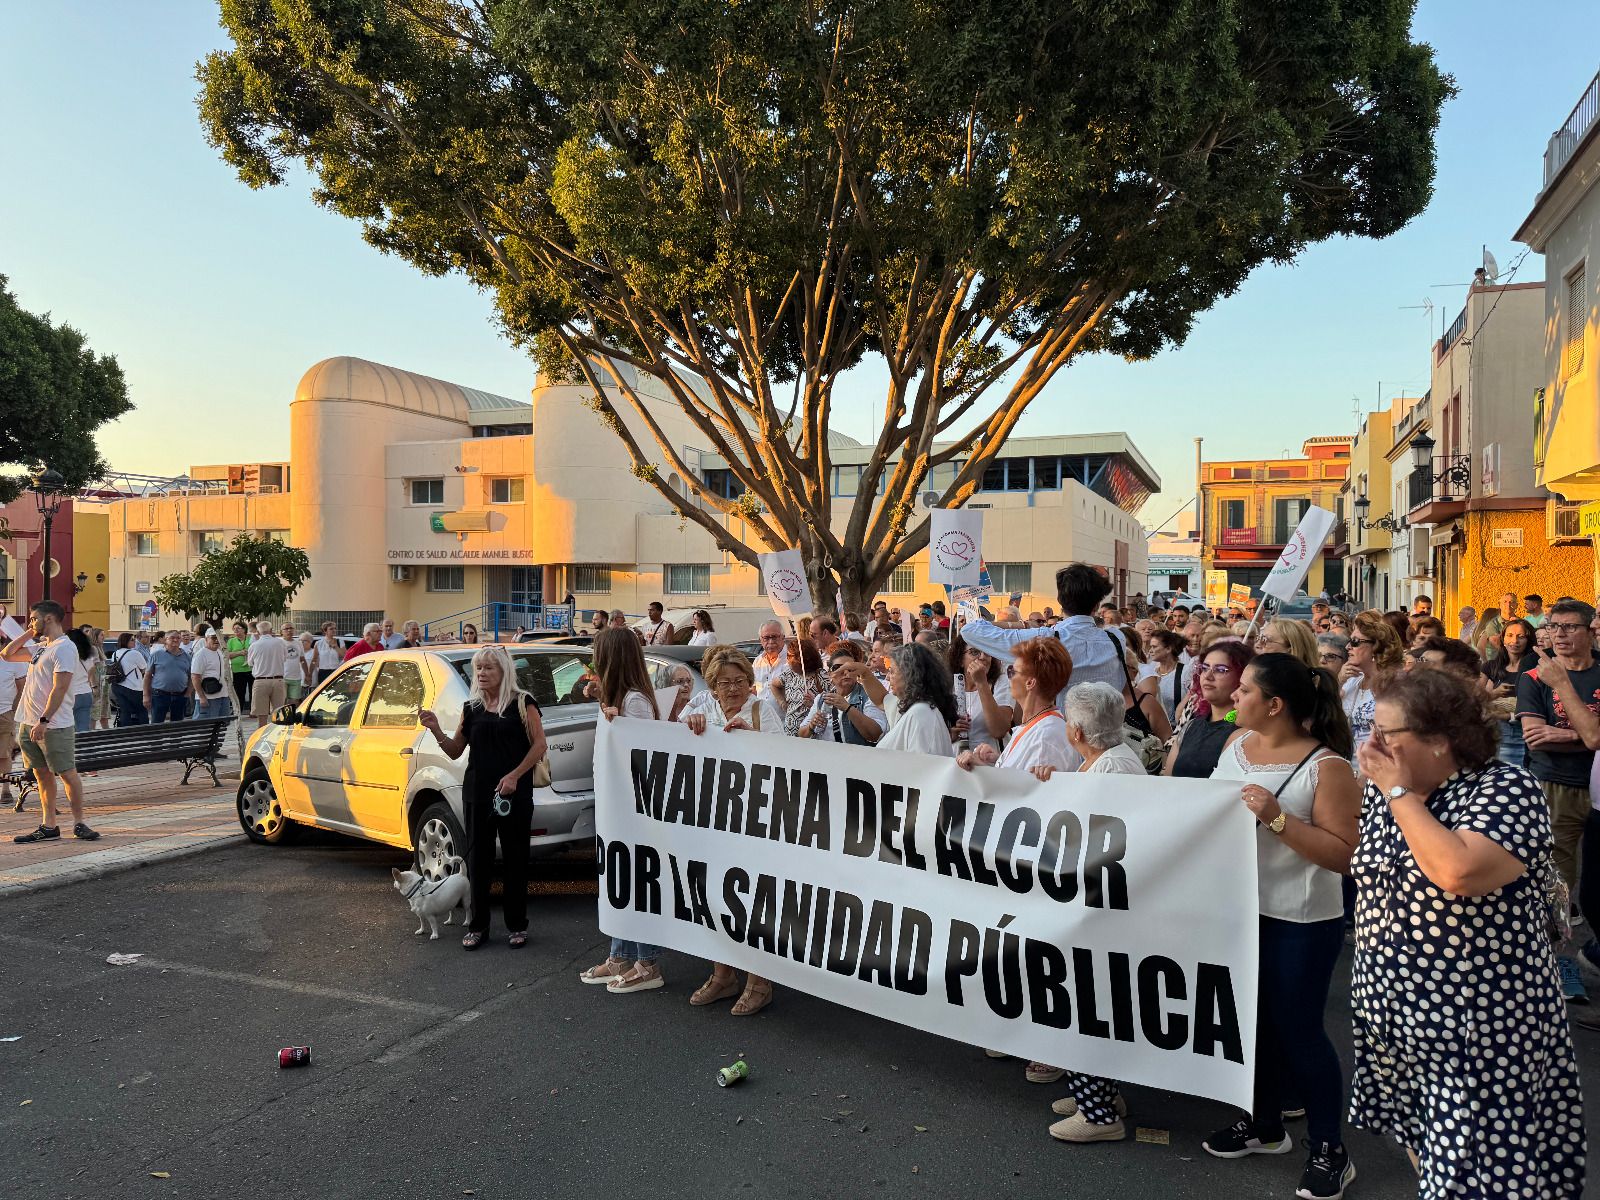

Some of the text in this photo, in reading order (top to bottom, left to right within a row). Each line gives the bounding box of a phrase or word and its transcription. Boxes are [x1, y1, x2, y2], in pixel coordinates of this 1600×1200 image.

[387, 550, 534, 559] CENTRO DE SALUD ALCALDE MANUEL BUSTO
[631, 749, 1129, 910] MAIRENA DEL ALCOR
[668, 853, 717, 931] LA
[721, 867, 932, 995] SANIDAD
[945, 914, 1244, 1065] PÚBLICA
